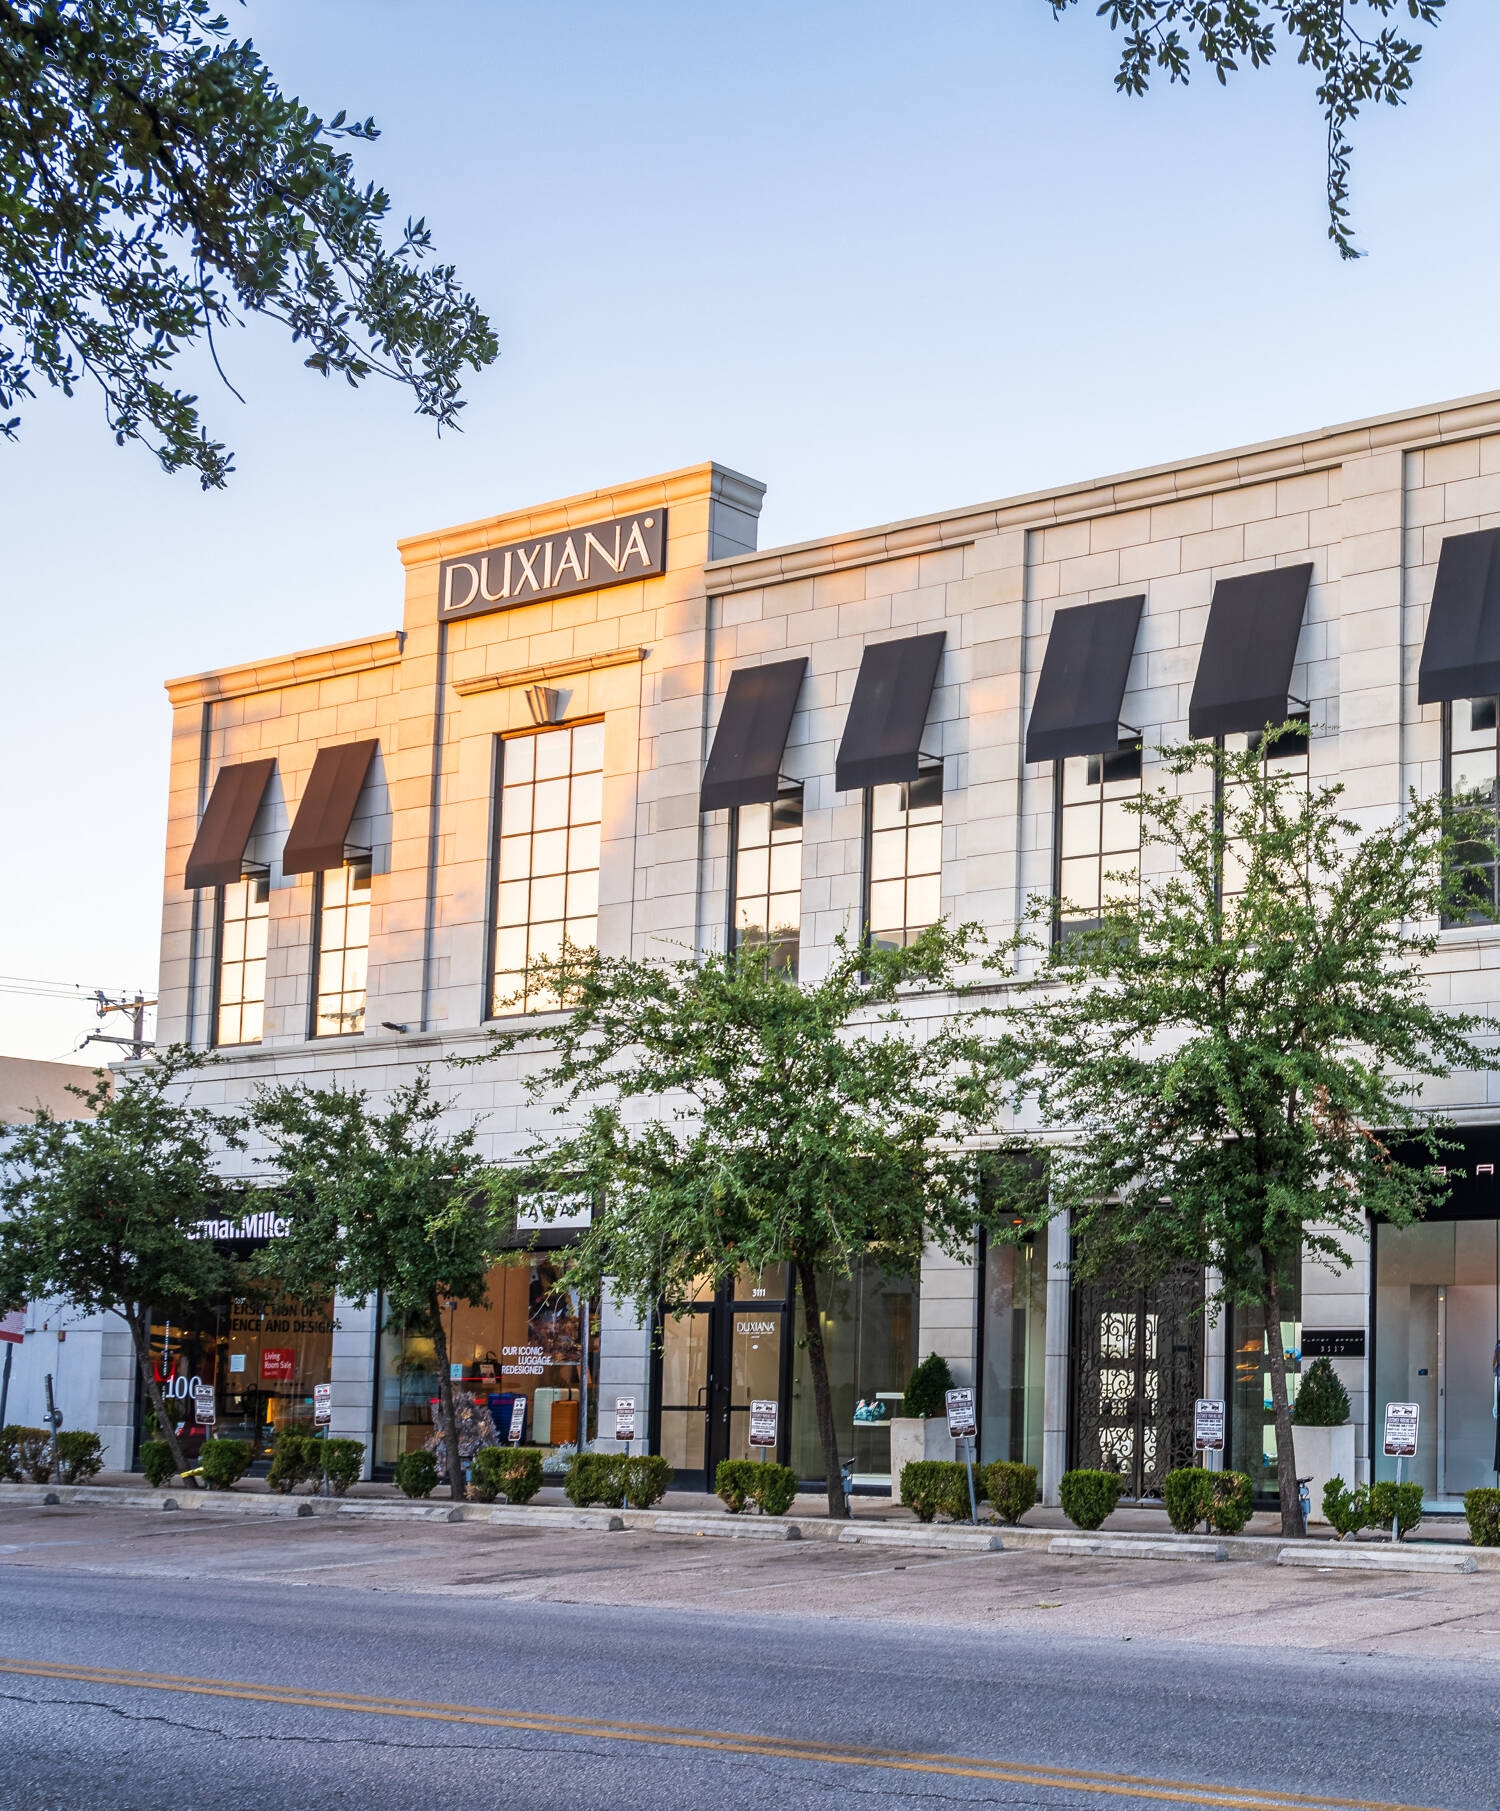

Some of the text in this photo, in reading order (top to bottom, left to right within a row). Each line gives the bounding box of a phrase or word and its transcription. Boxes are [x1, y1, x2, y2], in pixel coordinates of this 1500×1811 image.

[752, 1288, 766, 1297] 3111
[301, 1305, 315, 1318] OF
[265, 1319, 290, 1333] AND
[736, 1321, 775, 1332] DUXIANA
[502, 1346, 544, 1356] OUR ICONIC
[264, 1352, 280, 1362] Living
[518, 1356, 553, 1366] LUGGAGE,
[264, 1361, 292, 1369] Room Sale
[501, 1365, 544, 1375] REDESIGNED
[165, 1375, 202, 1399] 100
